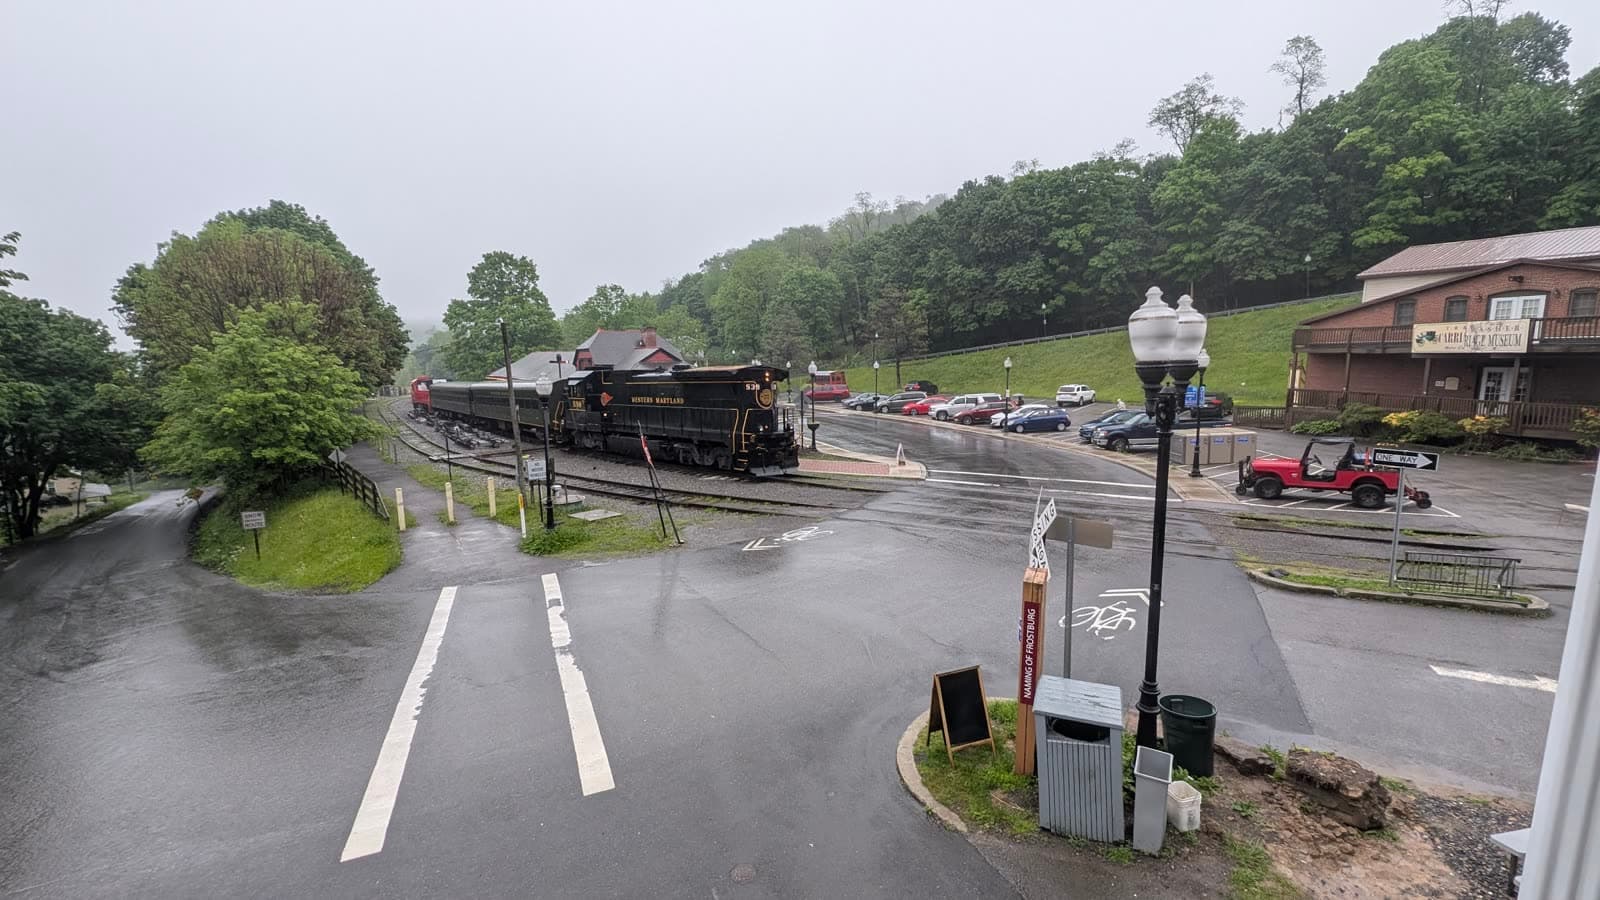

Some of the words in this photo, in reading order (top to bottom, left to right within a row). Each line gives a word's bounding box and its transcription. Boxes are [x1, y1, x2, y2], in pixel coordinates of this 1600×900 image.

[1488, 333, 1522, 347] MUSEUM
[1376, 453, 1393, 461] ONE
[1025, 608, 1036, 654] FROSTBURG
[1025, 655, 1033, 666] OF
[1023, 667, 1033, 699] NAMING
